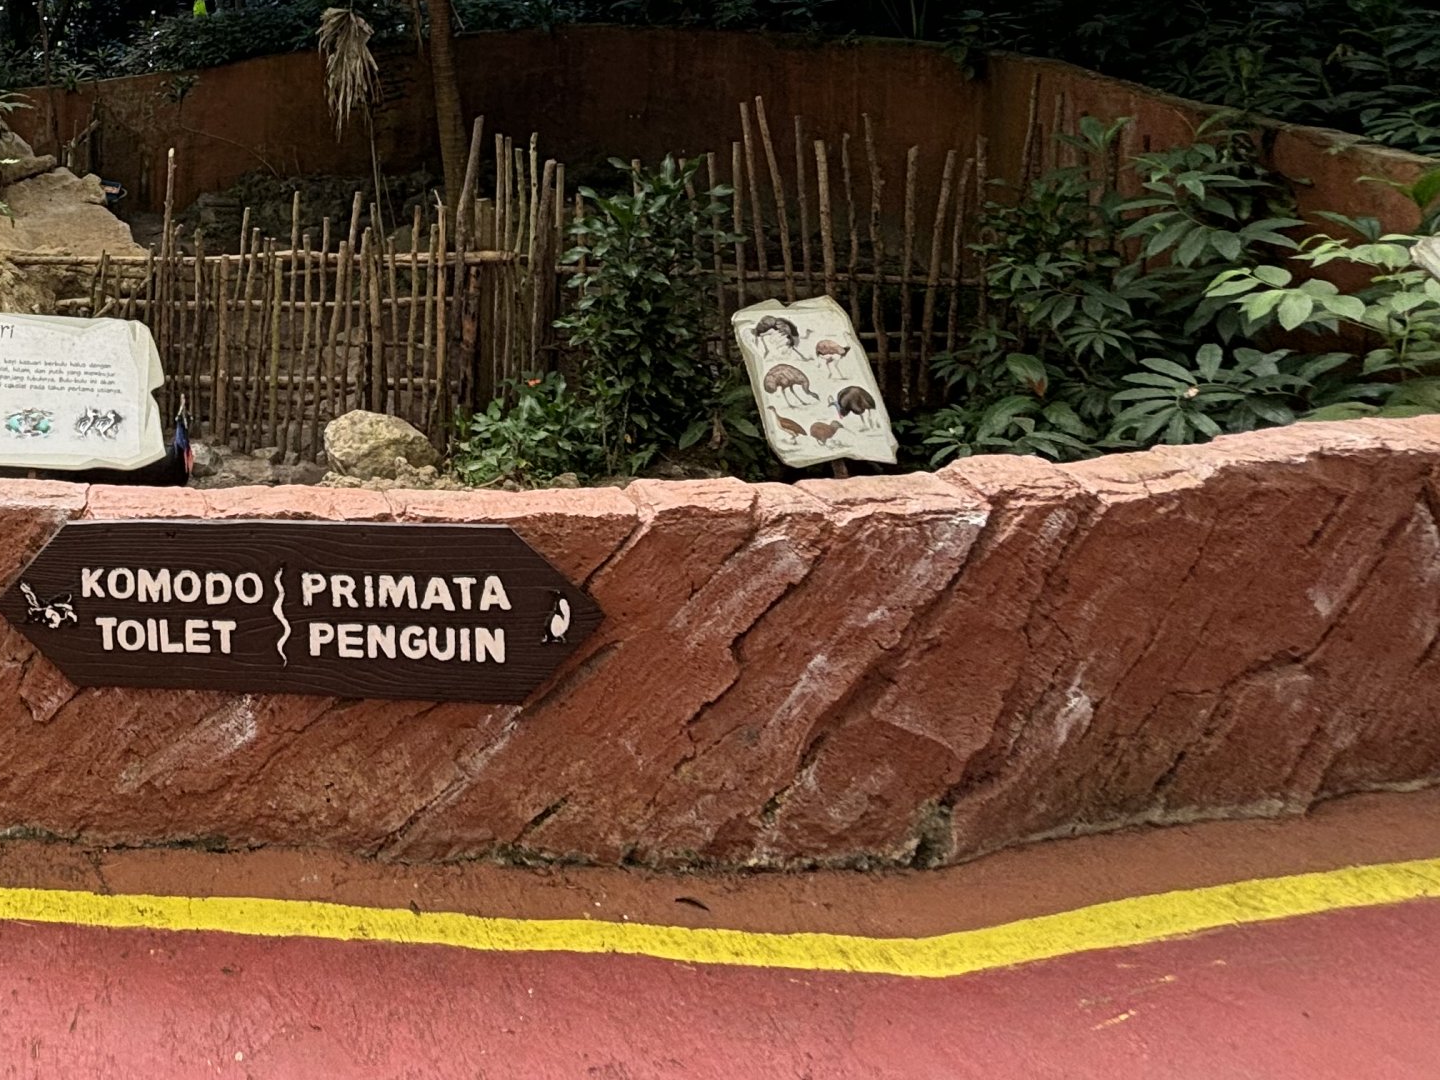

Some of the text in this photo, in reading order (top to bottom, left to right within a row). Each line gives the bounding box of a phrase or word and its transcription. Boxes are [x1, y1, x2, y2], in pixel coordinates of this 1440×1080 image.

[81, 567, 512, 611] KOMODO PRIMATA
[95, 617, 506, 664] TOILET PENGUIN
